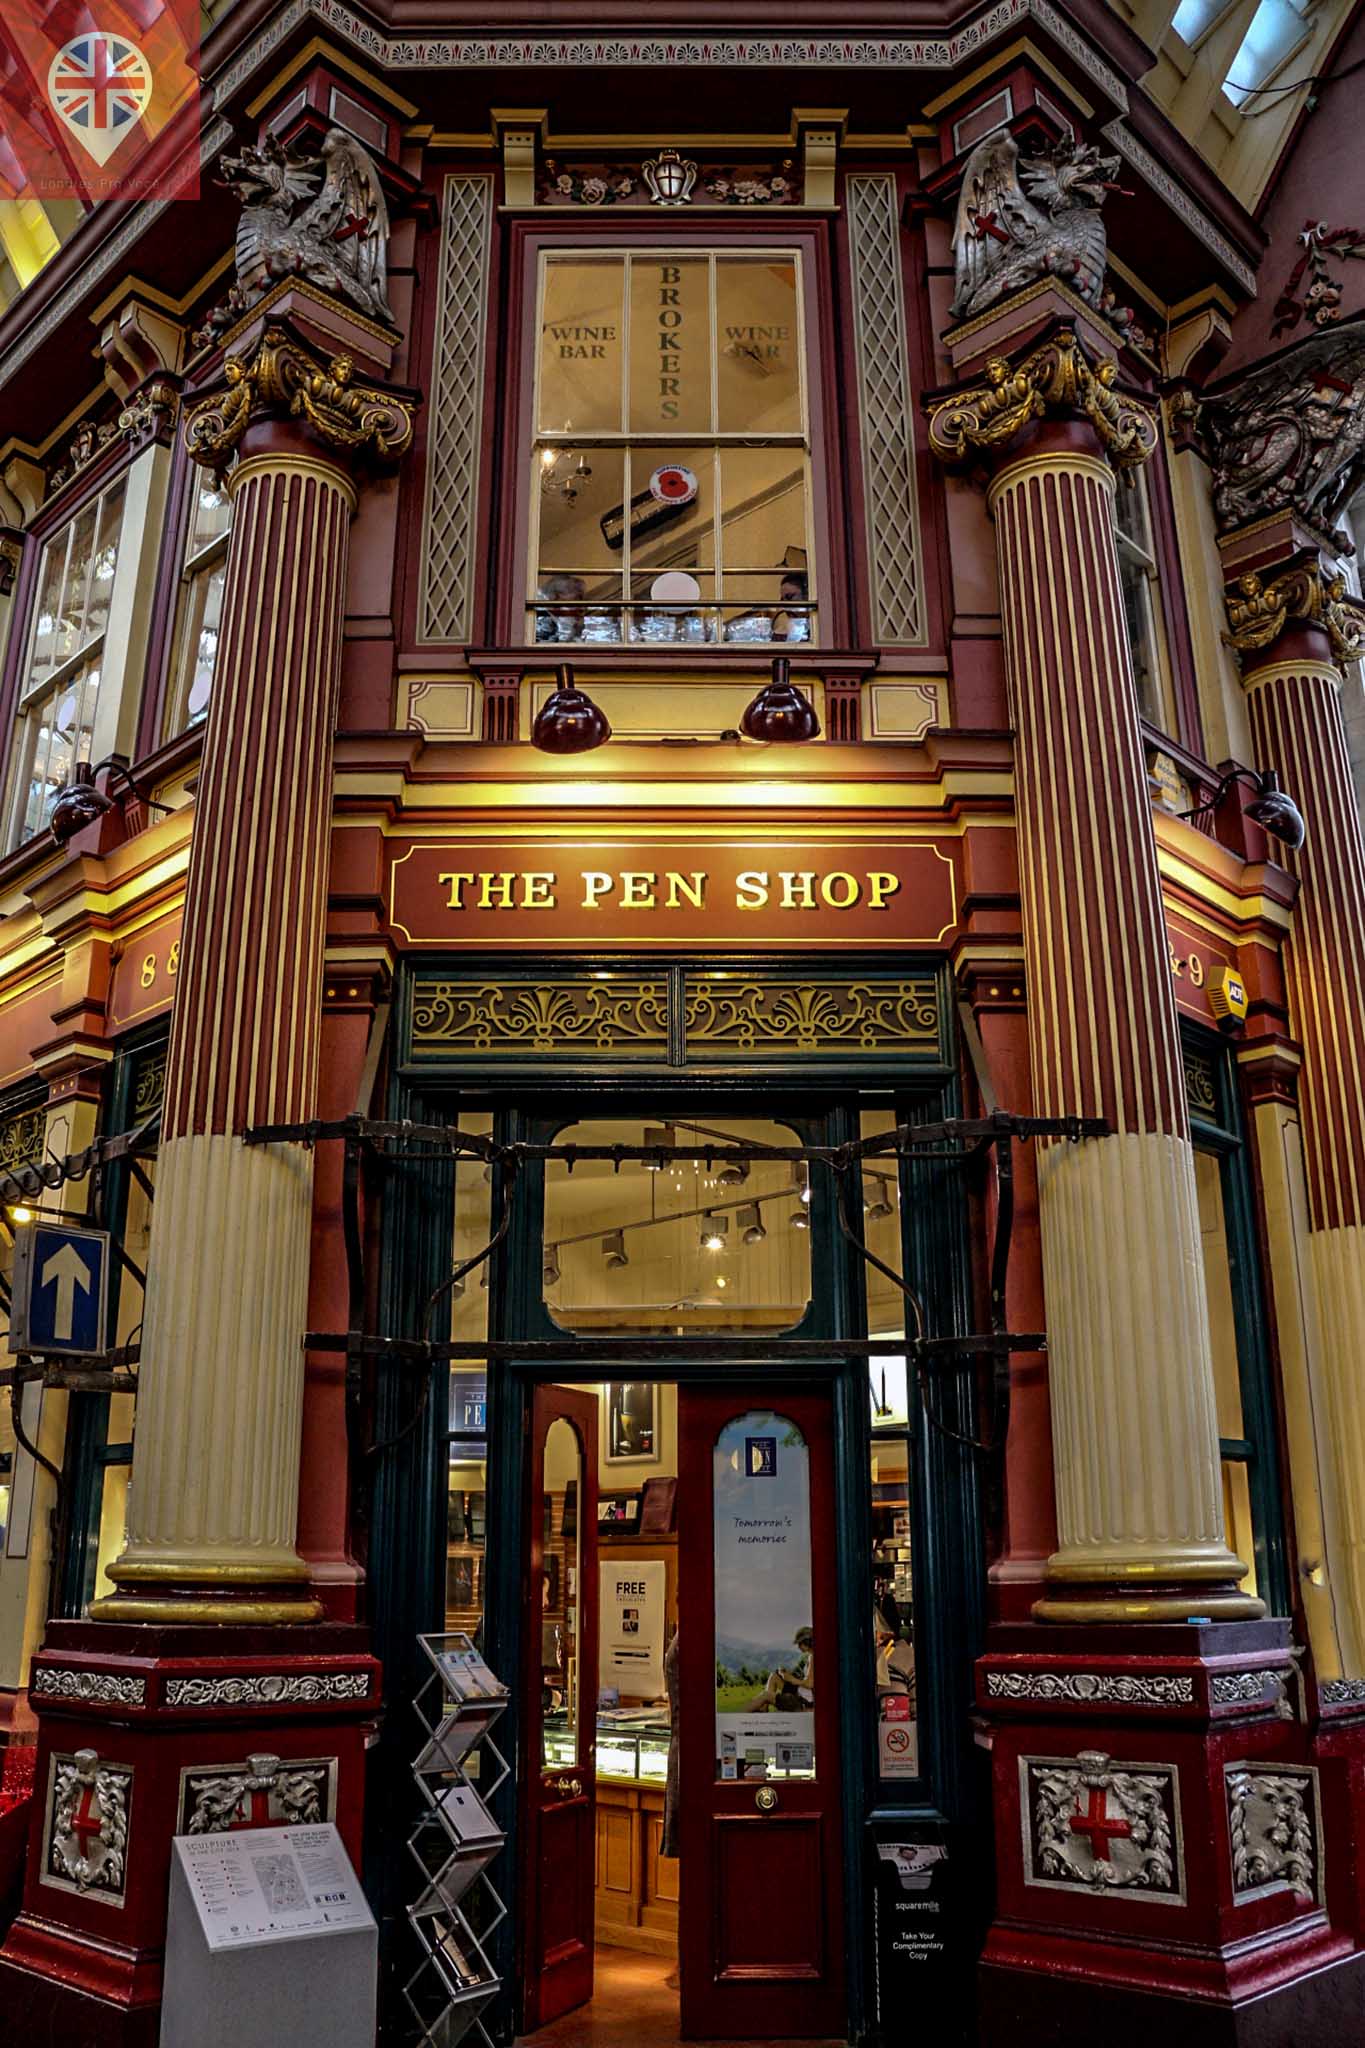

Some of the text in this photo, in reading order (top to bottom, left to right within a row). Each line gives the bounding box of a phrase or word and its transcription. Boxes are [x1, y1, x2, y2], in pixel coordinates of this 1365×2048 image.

[551, 327, 616, 341] WINE
[725, 326, 789, 341] WINE
[659, 266, 682, 420] BROKERS
[560, 345, 606, 359] BAR
[736, 344, 780, 359] BAR
[439, 872, 900, 908] THE PEN SHOP
[140, 953, 156, 989] 8
[1188, 953, 1204, 987] 9
[1229, 984, 1244, 1002] ADT
[616, 1582, 647, 1595] FREE
[901, 1931, 935, 1940] Take Your
[892, 1941, 944, 1951] Complimentary
[909, 1951, 928, 1961] Copy
